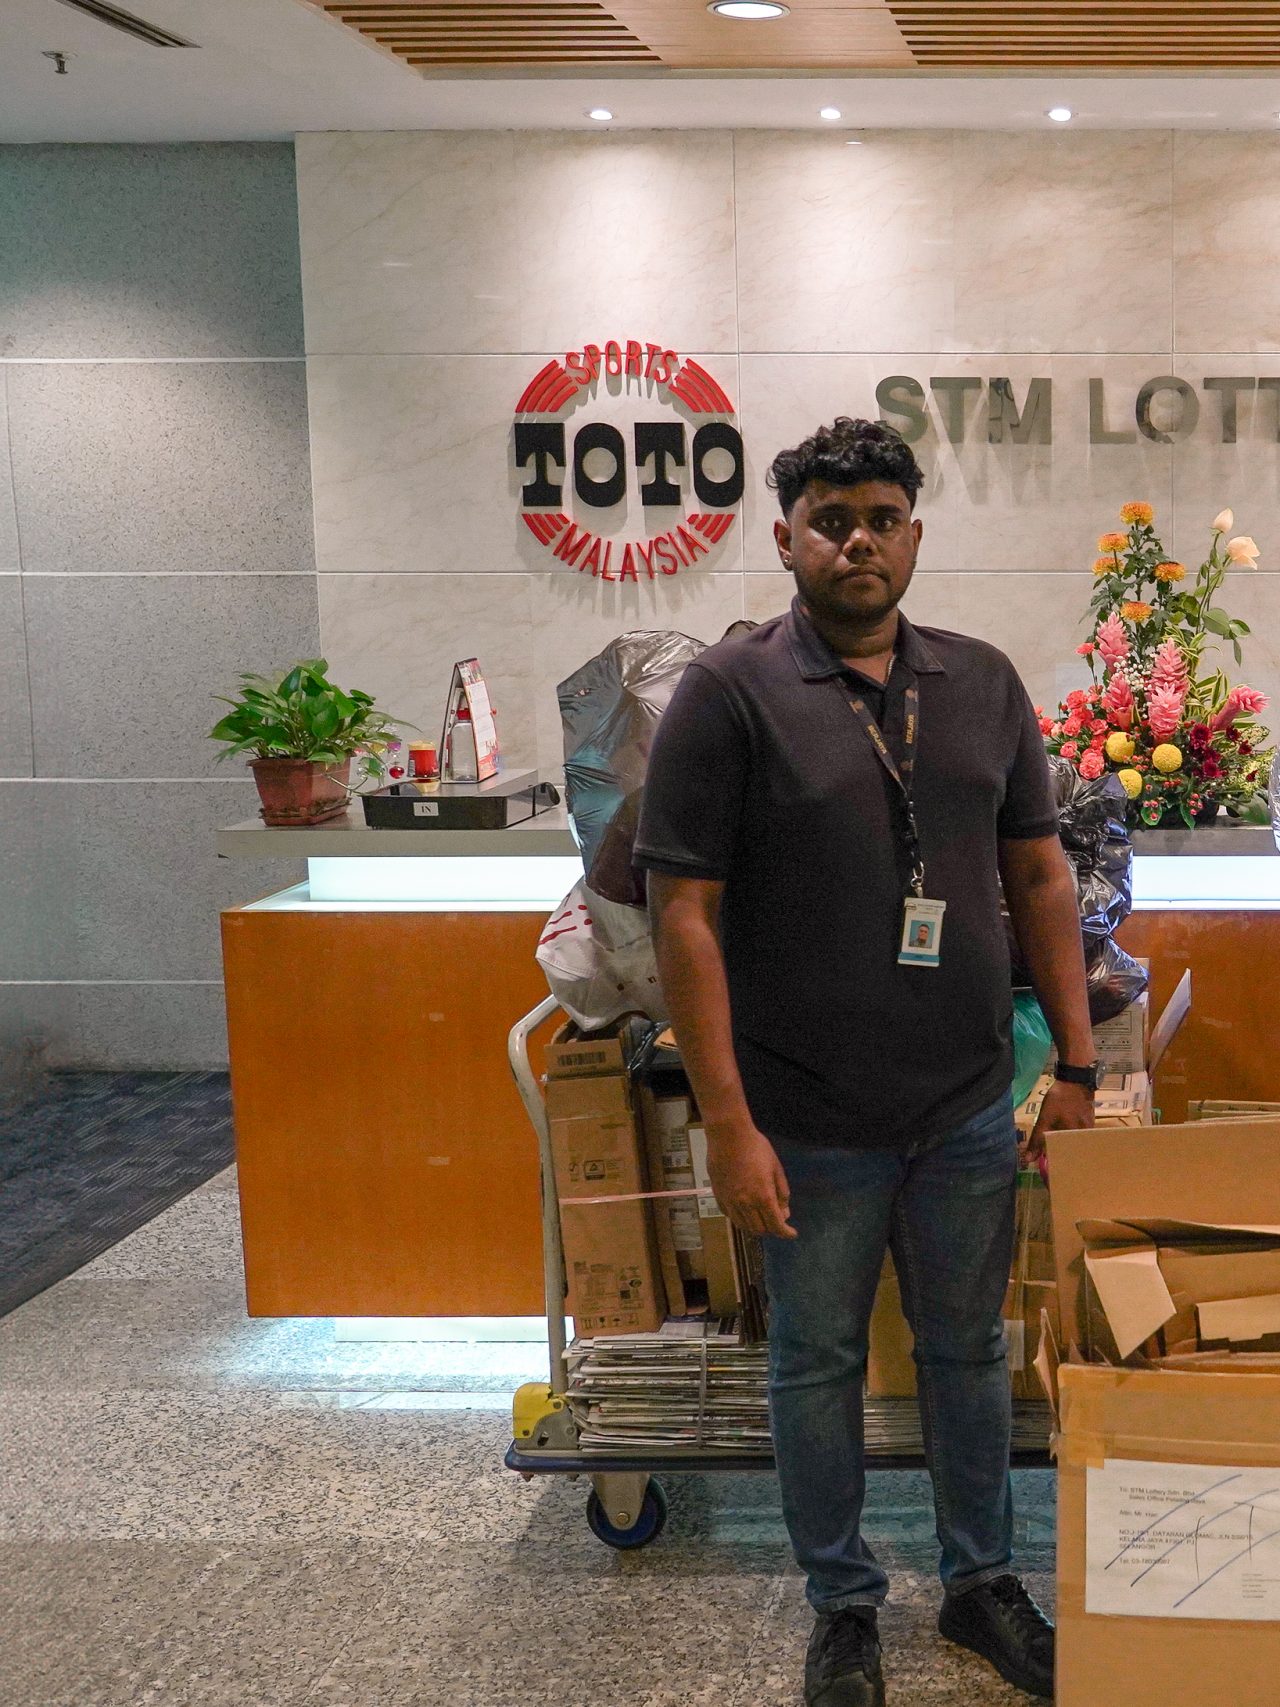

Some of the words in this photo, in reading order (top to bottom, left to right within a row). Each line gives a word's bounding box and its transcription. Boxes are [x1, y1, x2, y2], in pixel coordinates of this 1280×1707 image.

[565, 340, 678, 384] SPORTS
[875, 376, 1052, 444] STM
[514, 422, 745, 507] TOTO
[553, 523, 709, 582] MALAYSIA
